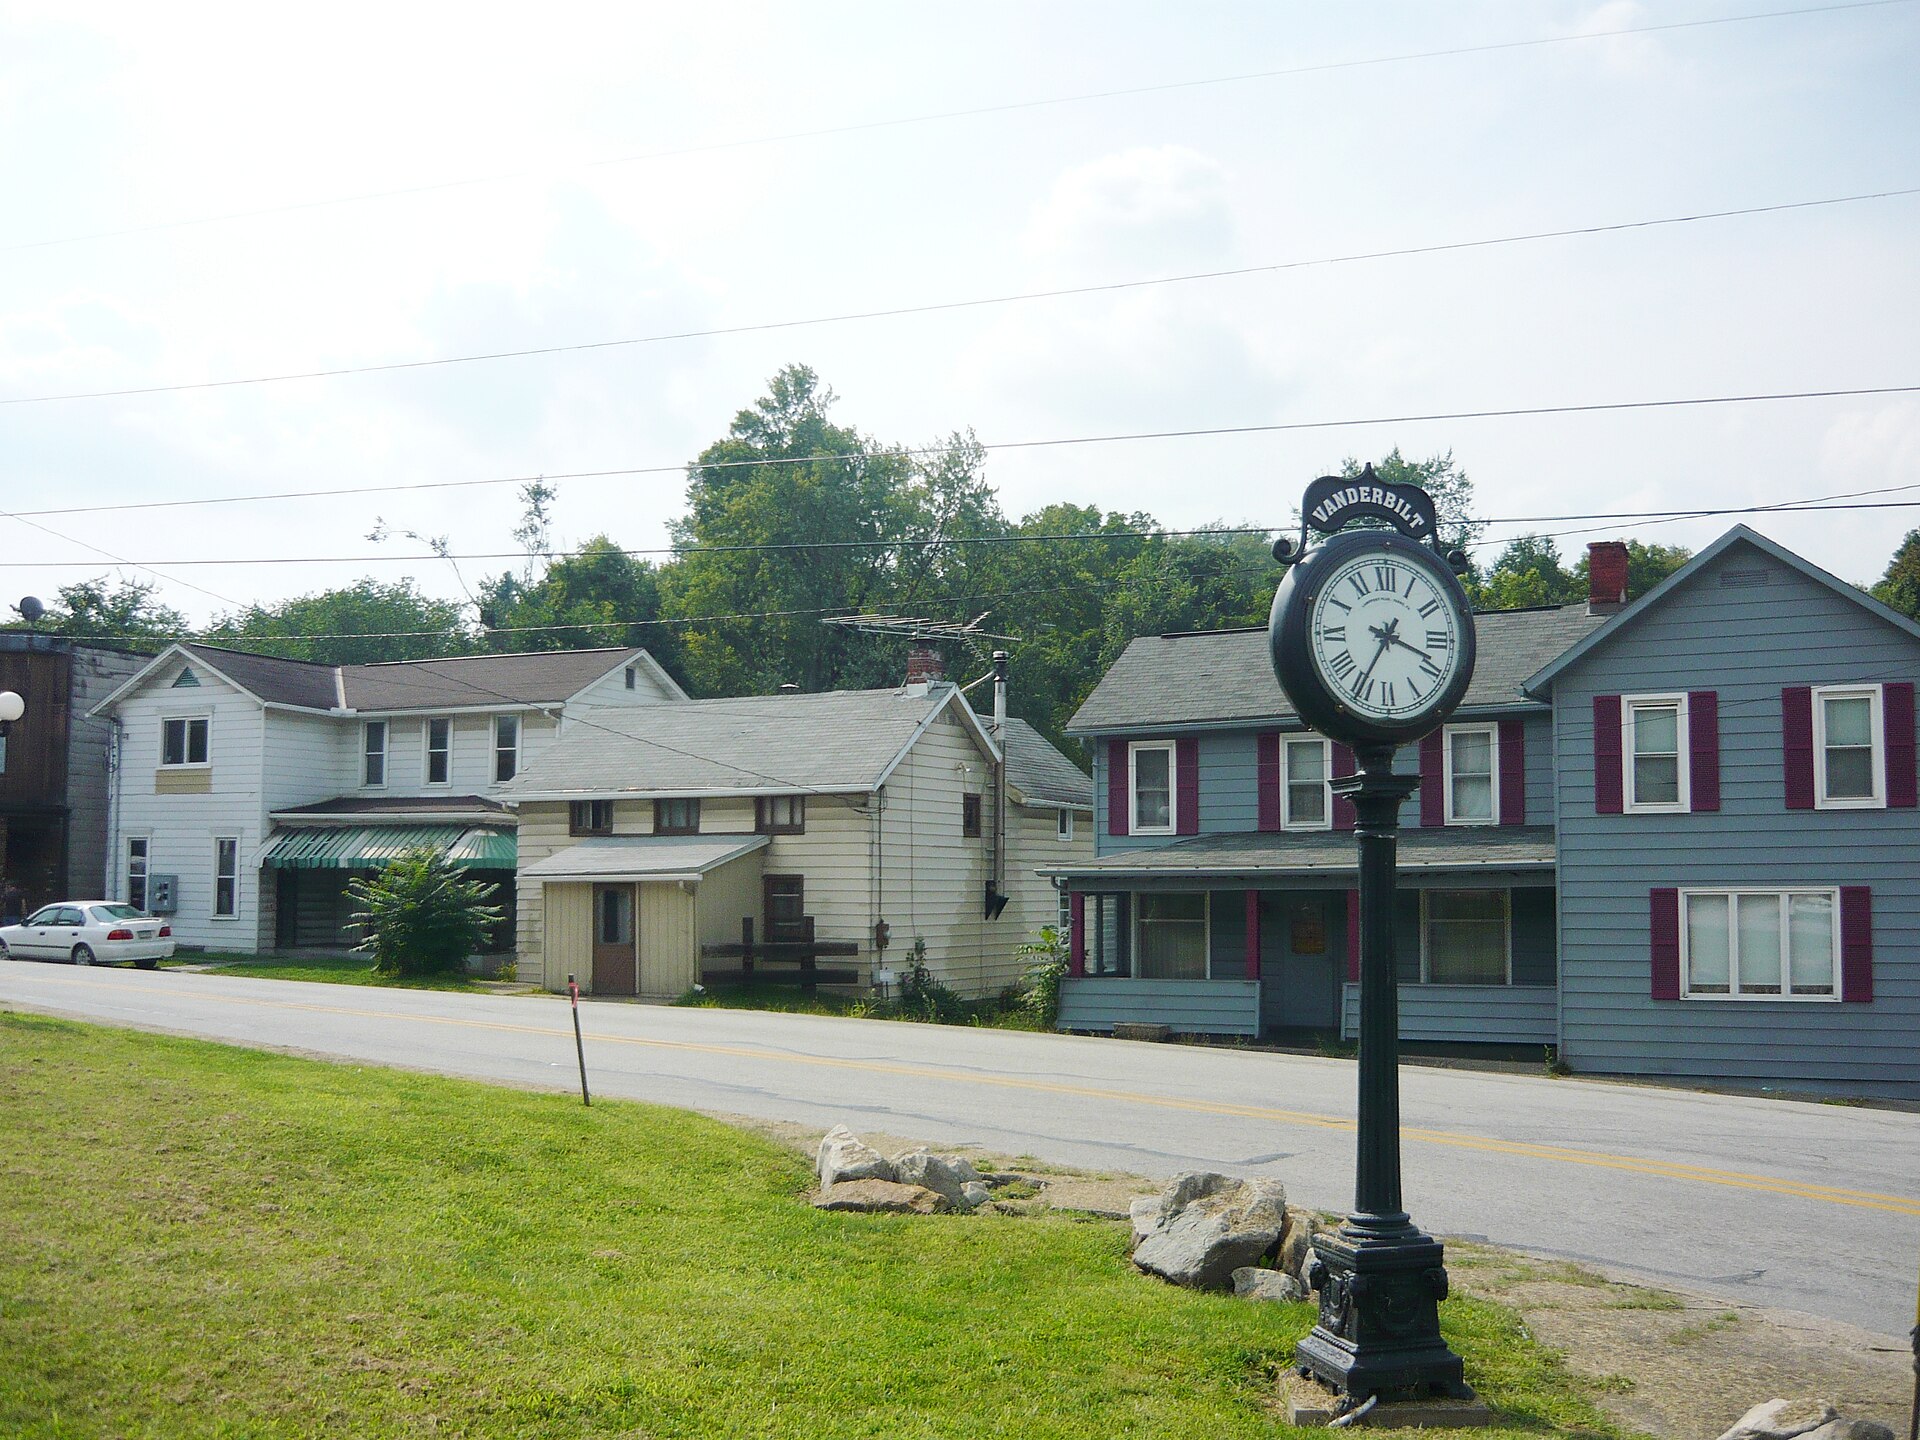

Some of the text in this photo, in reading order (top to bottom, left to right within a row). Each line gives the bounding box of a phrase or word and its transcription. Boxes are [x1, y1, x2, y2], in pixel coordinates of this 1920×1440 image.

[1312, 487, 1424, 528] VANDERBILT
[1347, 571, 1371, 600] XI
[1375, 566, 1396, 592] XII
[1403, 576, 1416, 599] I
[1328, 594, 1352, 616] X
[1417, 597, 1440, 619] II
[1323, 625, 1346, 642] IX
[1425, 630, 1448, 650] III
[1329, 648, 1357, 681] VIII
[1418, 656, 1442, 683] IV
[1349, 671, 1375, 701] VI
[1381, 681, 1396, 706] VI
[1406, 676, 1422, 701] V
